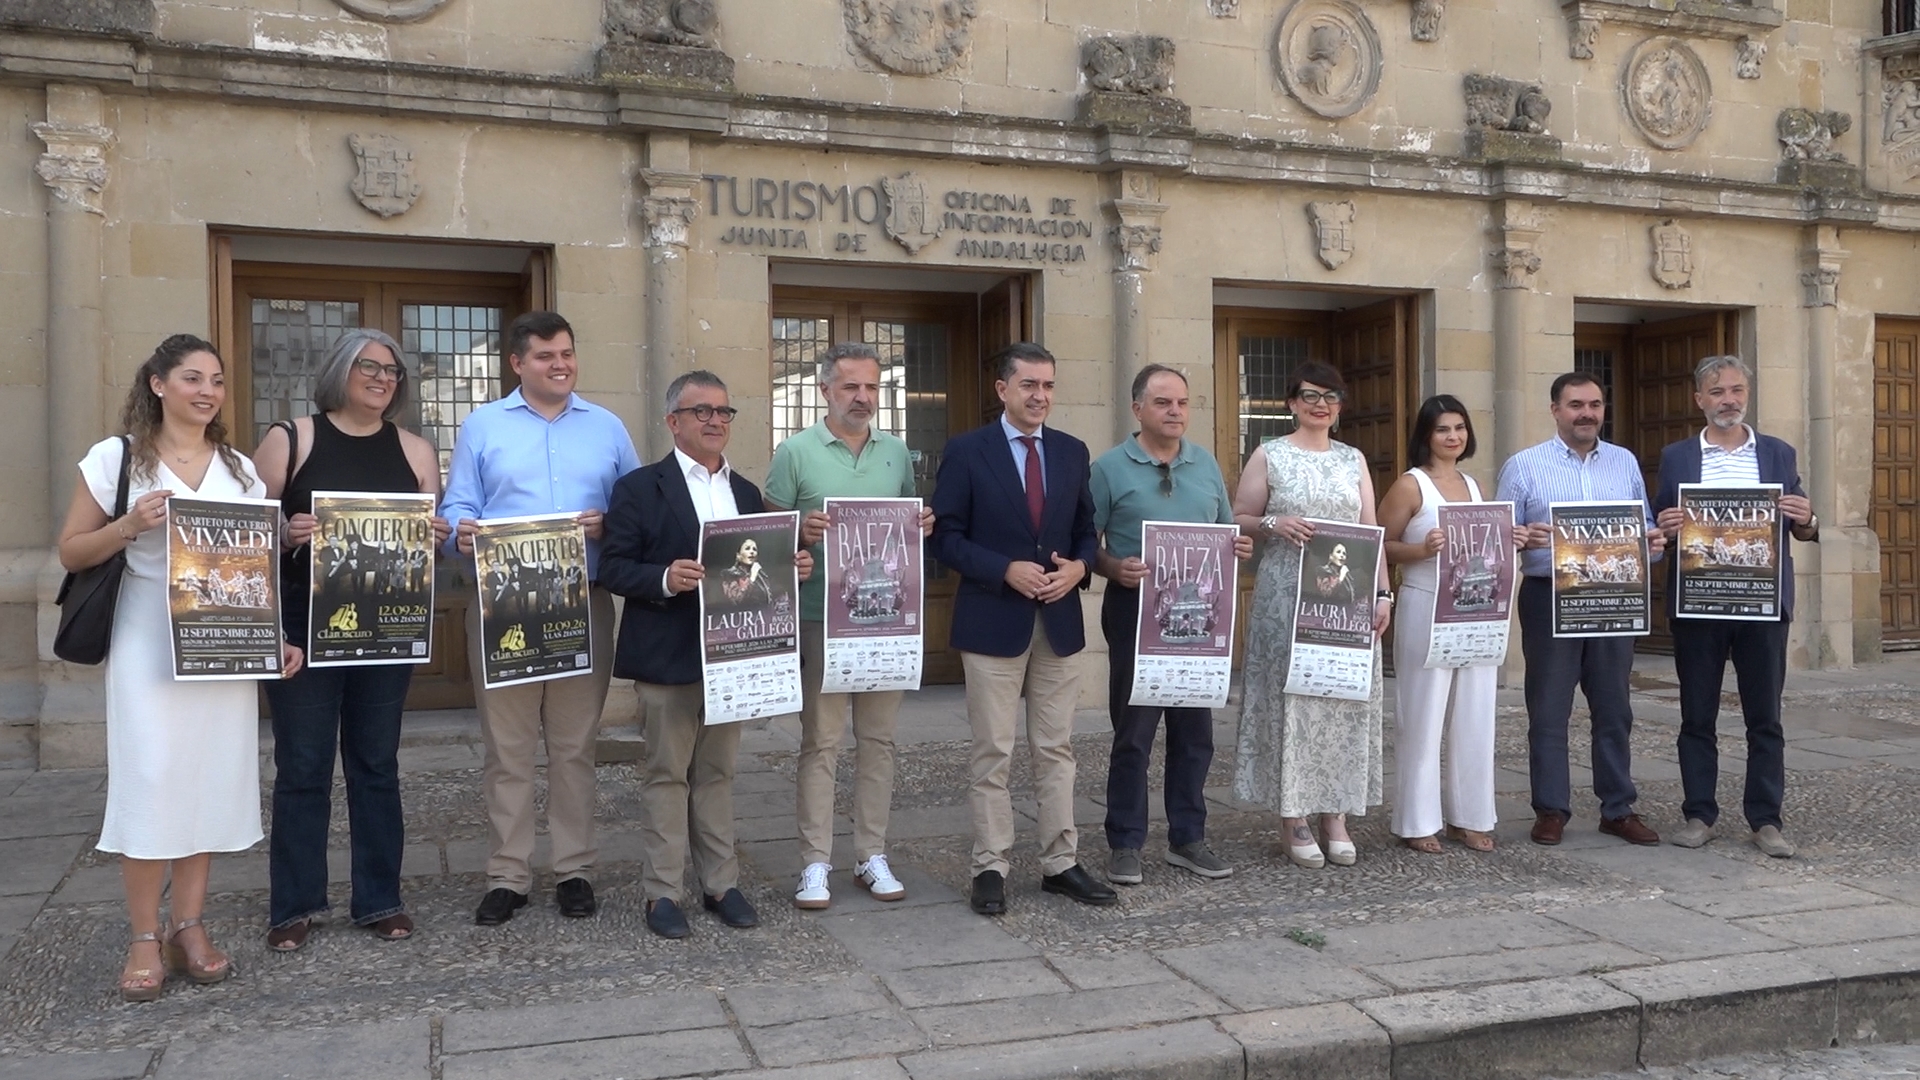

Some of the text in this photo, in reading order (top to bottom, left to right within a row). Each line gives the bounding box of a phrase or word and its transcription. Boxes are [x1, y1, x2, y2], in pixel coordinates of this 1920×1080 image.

[702, 174, 879, 224] TURISMO
[944, 191, 1076, 216] OFICINA DE
[944, 212, 1092, 238] INFORMACION
[721, 226, 1086, 262] JUNTA DE ANDALUCIA
[176, 515, 222, 527] CUARTETO
[224, 519, 236, 528] DE
[838, 508, 910, 517] RENACIMIENTO
[1686, 507, 1775, 522] VIVALDI
[176, 526, 273, 549] VIVALDI
[321, 518, 427, 542] CONCIERTO
[1156, 532, 1226, 542] RENACIMIENTO
[1559, 524, 1641, 539] VIVALDI
[484, 537, 579, 566] CONCIERTO
[838, 522, 909, 567] BAEZA
[1447, 524, 1505, 563] BAEZA
[1154, 546, 1223, 590] BAEZA
[379, 605, 427, 616] 12.09.26
[707, 610, 765, 631] LAURA
[1301, 602, 1347, 619] LAURA
[180, 628, 275, 638] 12 SEPTIEMBRE 2026
[543, 619, 586, 633] 12.09.26
[737, 621, 794, 640] GALLEGO
[1323, 618, 1371, 632] GALLEGO
